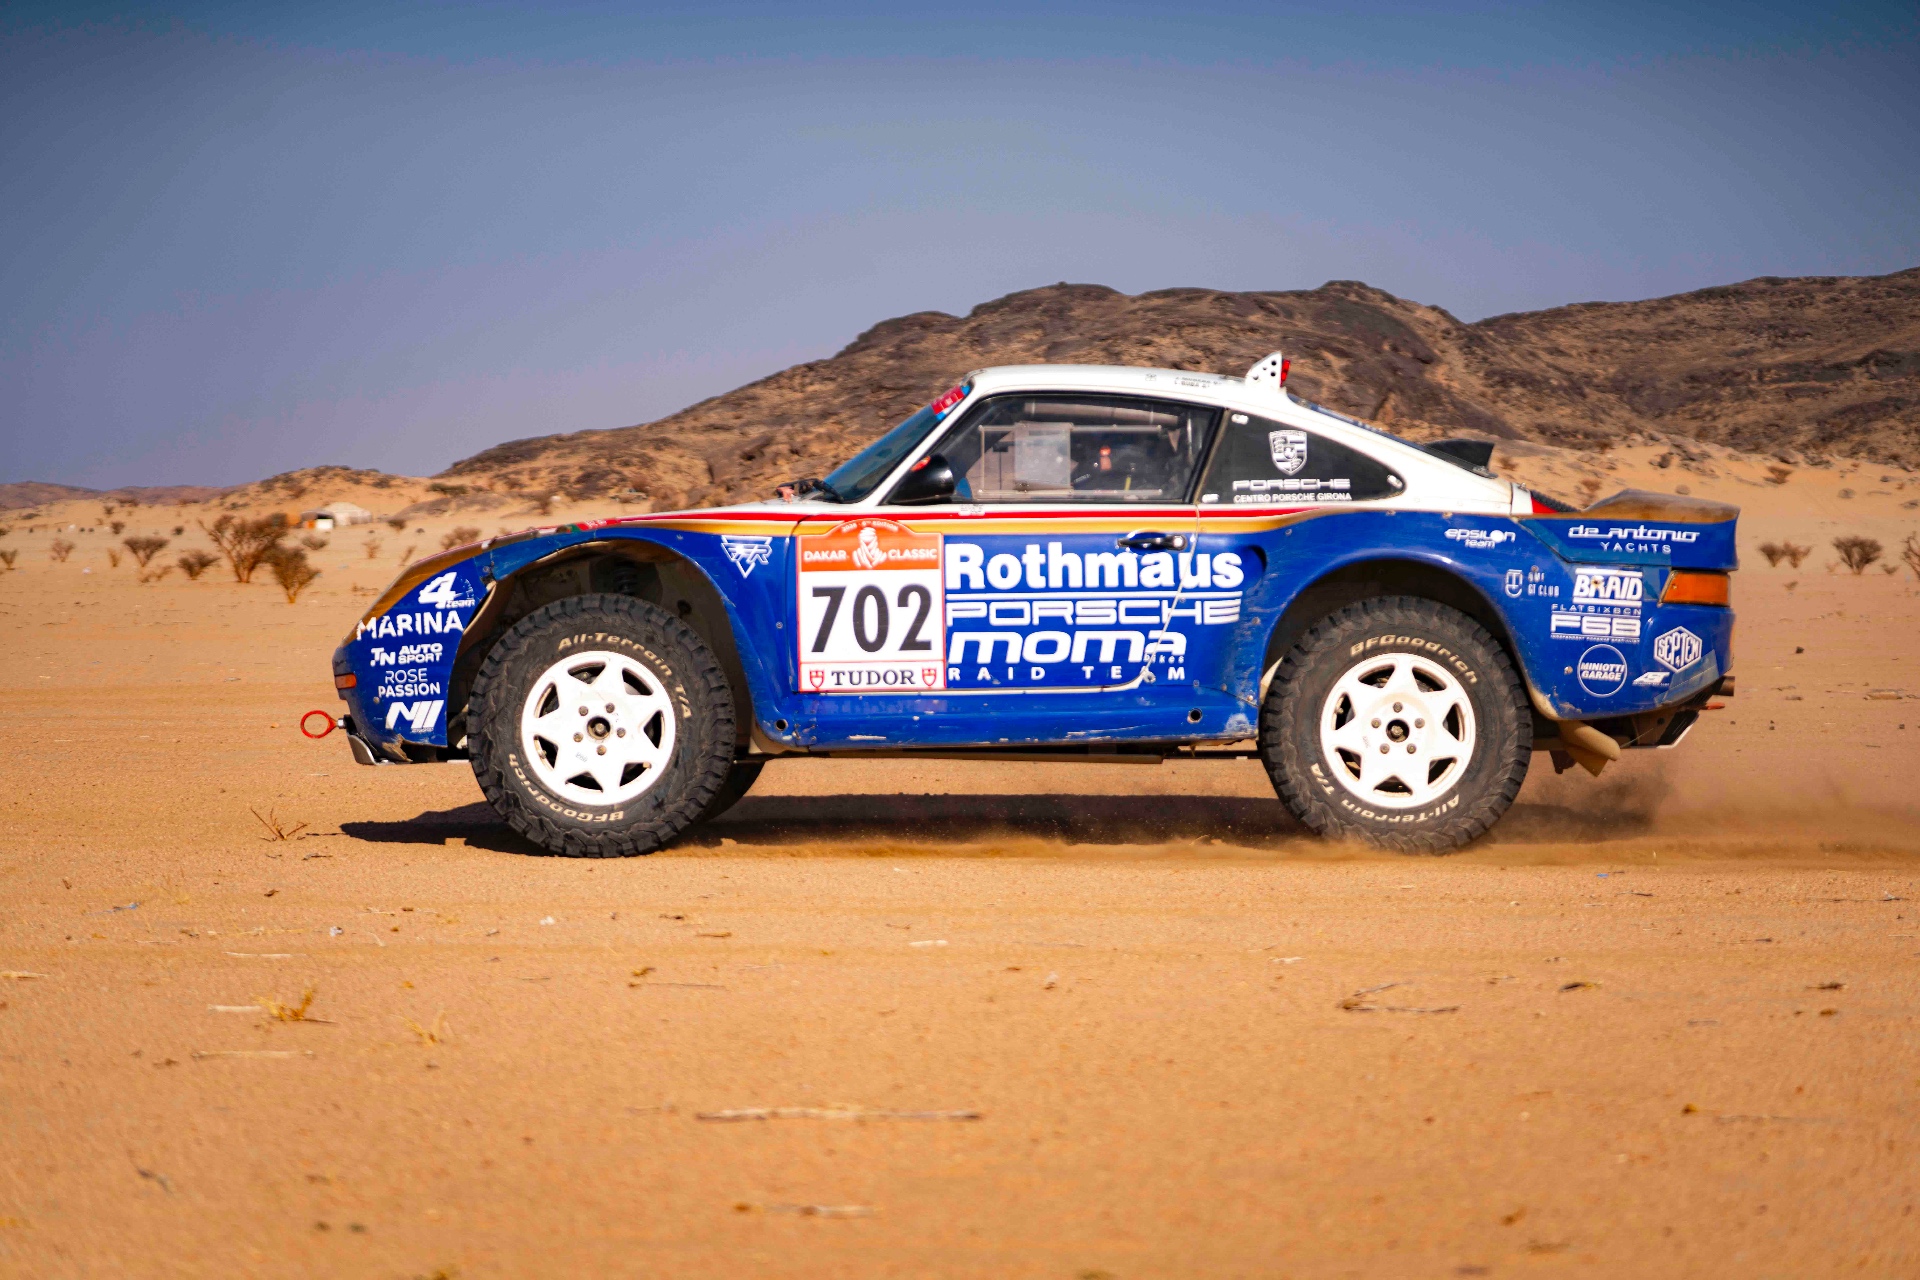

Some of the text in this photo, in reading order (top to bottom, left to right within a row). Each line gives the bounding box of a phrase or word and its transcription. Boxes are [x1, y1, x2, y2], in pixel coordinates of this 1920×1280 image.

[1233, 478, 1350, 491] PORSCHE
[1234, 492, 1352, 503] CENTRO PORSCHE GIRONA
[804, 548, 938, 561] DAKAR CLASSIC
[1600, 541, 1672, 554] YACHTS
[944, 542, 1244, 589] Rothmaus
[1573, 573, 1642, 600] BRAID
[946, 600, 1242, 626] PORSCHE
[1551, 603, 1642, 615] FLATSIXBCN
[356, 610, 464, 641] MARINA
[811, 584, 932, 652] 702
[1550, 614, 1641, 637] F6B
[399, 643, 443, 655] AUTO
[948, 630, 1187, 664] moma
[398, 653, 443, 664] SPORT
[1143, 654, 1184, 664] bikes
[1351, 634, 1478, 684] BFGoodrich
[384, 668, 428, 684] ROSE
[558, 632, 692, 718] All-Terrain T/A
[948, 667, 1045, 680] RAID
[1580, 662, 1625, 673] MINIOTTI
[1581, 670, 1622, 682] GARAGE
[831, 669, 916, 686] TUDOR
[378, 681, 441, 698] PASSION
[508, 753, 624, 822] BFGoodrich
[1310, 762, 1460, 823] All-Terrain T/A
